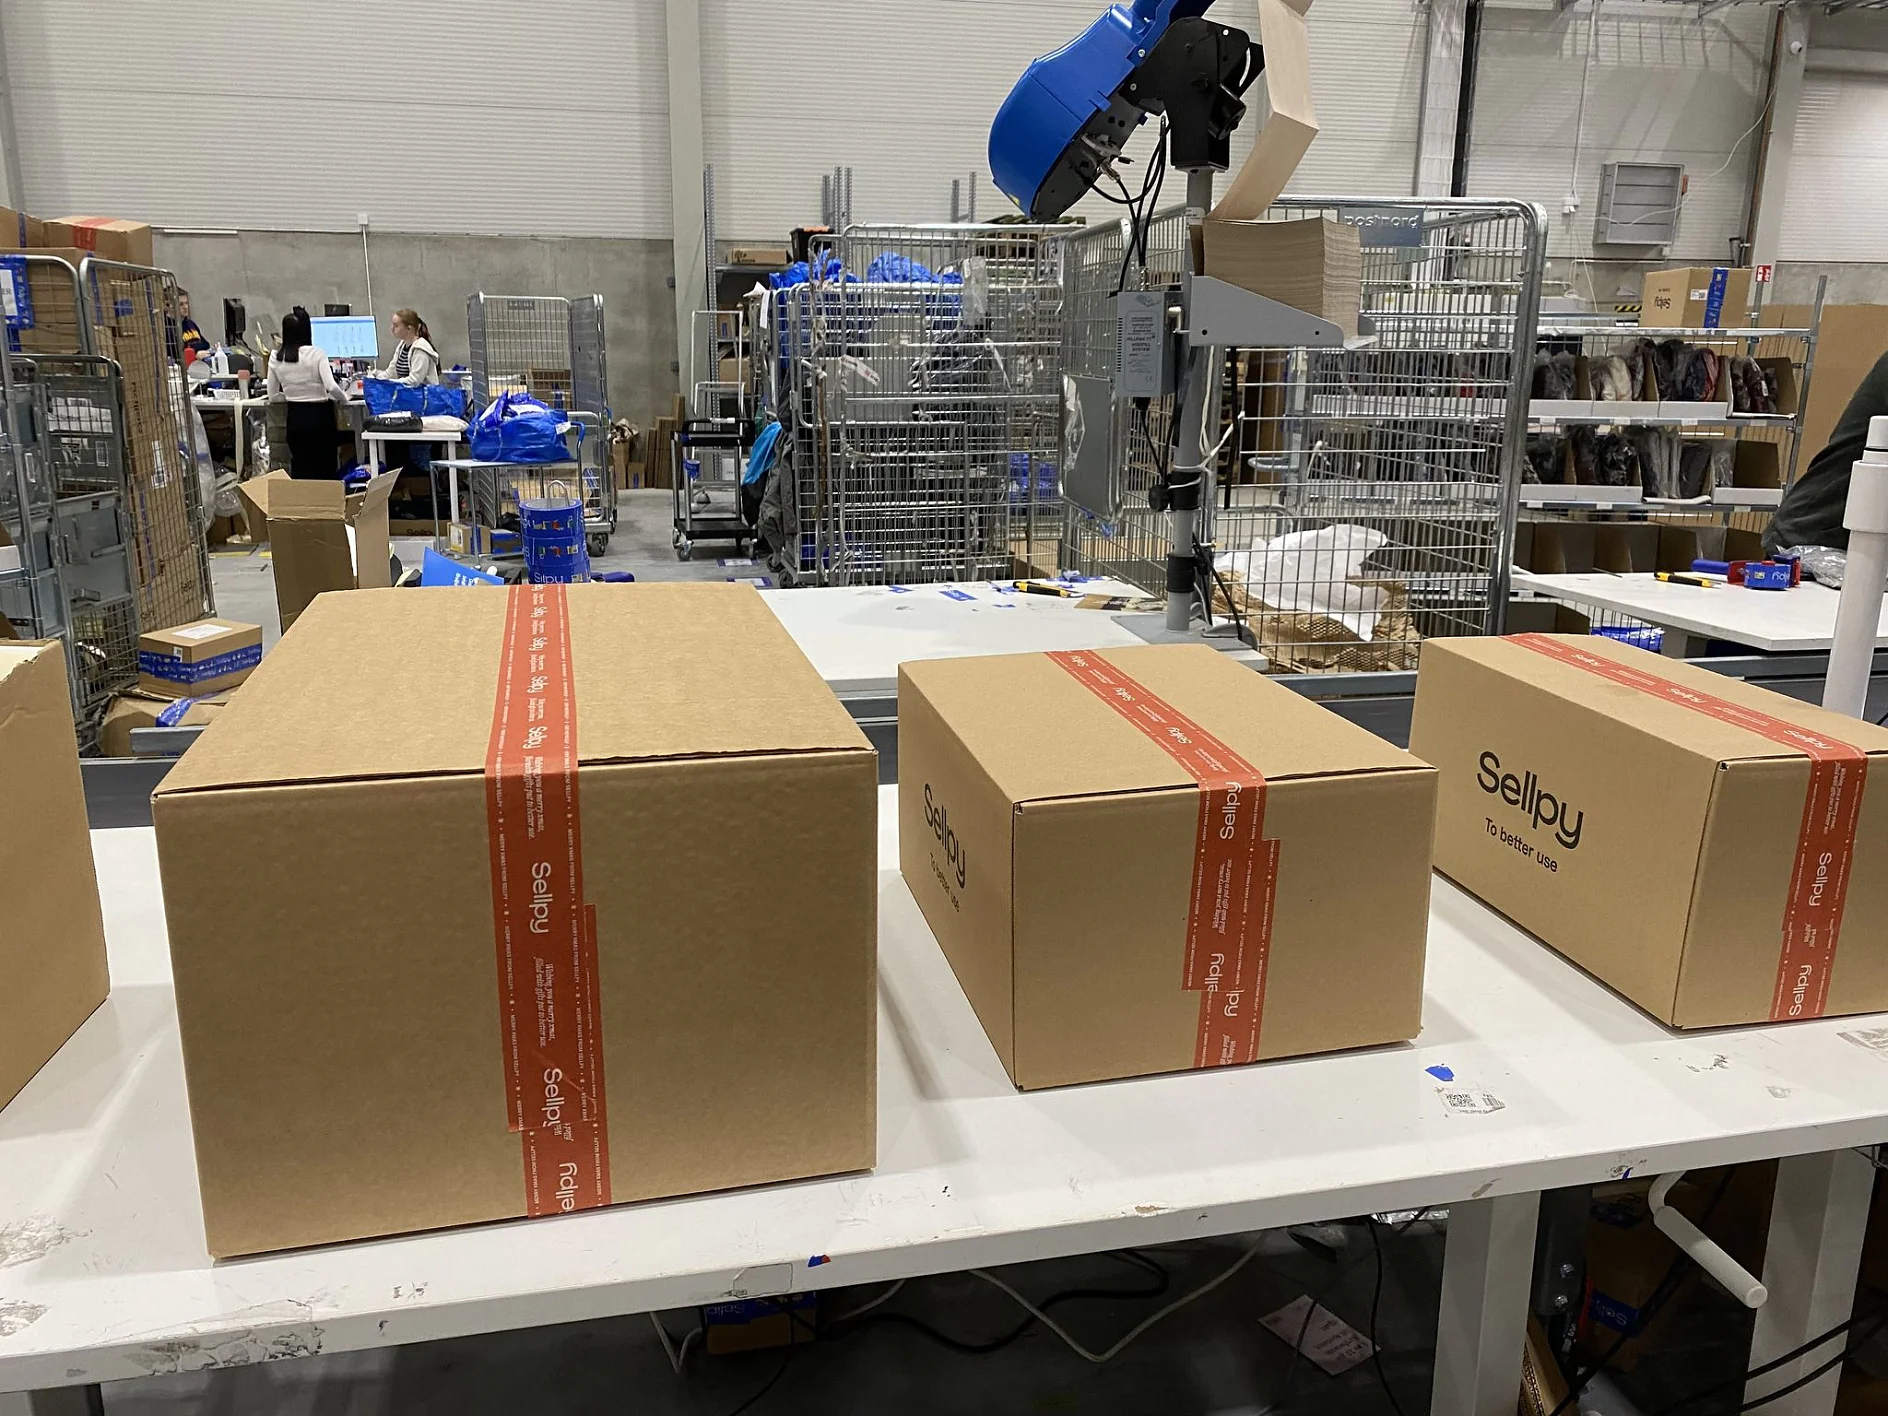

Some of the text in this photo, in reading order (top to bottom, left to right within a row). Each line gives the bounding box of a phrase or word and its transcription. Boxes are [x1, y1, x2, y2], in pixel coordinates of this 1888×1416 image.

[1220, 782, 1242, 840] Sellpy
[1476, 751, 1584, 849] Sellpy
[924, 783, 966, 889] Sellpy
[1486, 817, 1558, 872] To better use
[530, 862, 553, 934] Sellpy
[1808, 852, 1832, 906] Sellpy
[1204, 954, 1224, 992] ellpy
[1789, 964, 1812, 1016] Sellpy
[556, 1162, 578, 1212] ellpy
